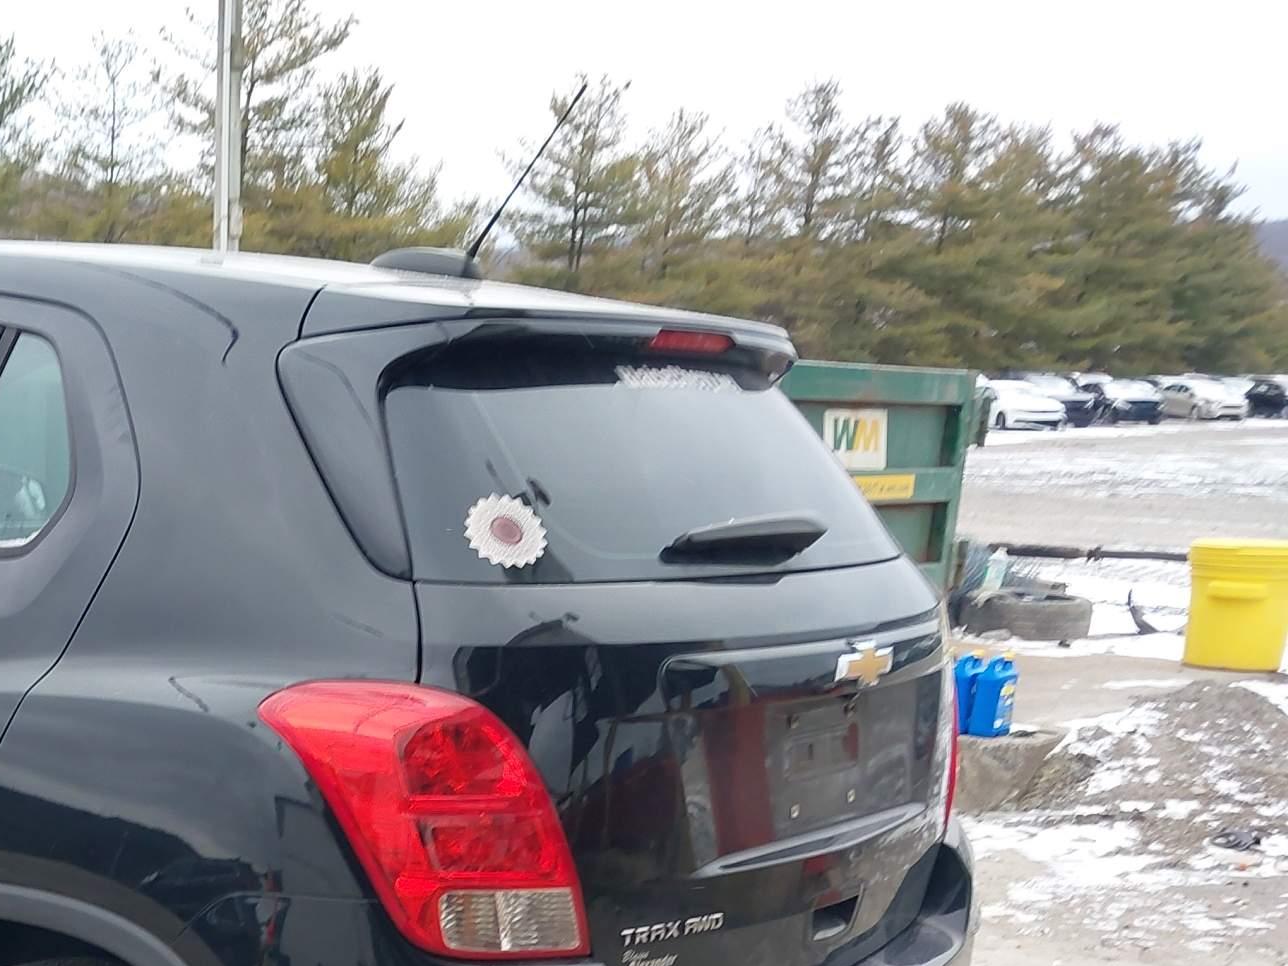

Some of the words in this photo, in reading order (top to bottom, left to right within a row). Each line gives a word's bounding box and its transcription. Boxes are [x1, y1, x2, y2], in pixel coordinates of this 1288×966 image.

[833, 416, 880, 454] WM
[620, 919, 681, 947] TRAX
[684, 912, 724, 936] AWD
